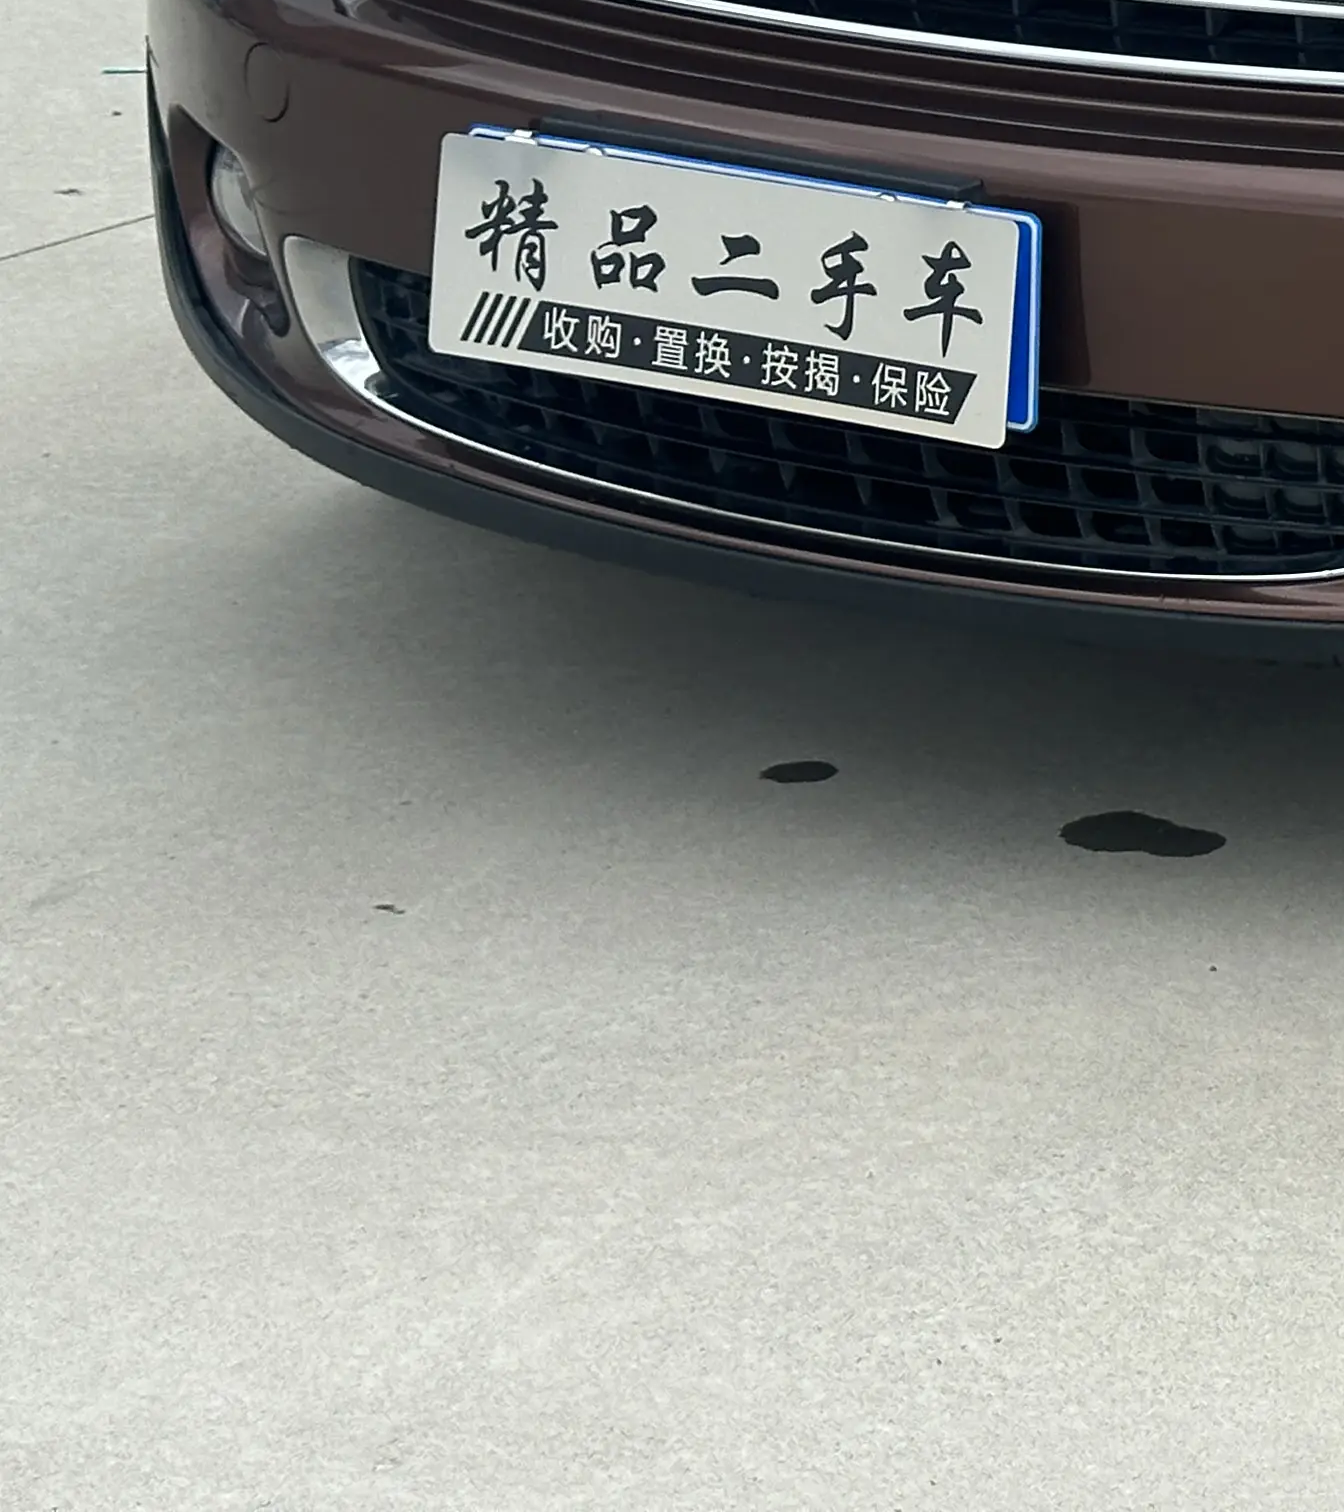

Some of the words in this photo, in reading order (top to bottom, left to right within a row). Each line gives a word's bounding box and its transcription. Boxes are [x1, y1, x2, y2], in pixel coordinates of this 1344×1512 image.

[464, 178, 984, 358] 精品二手车
